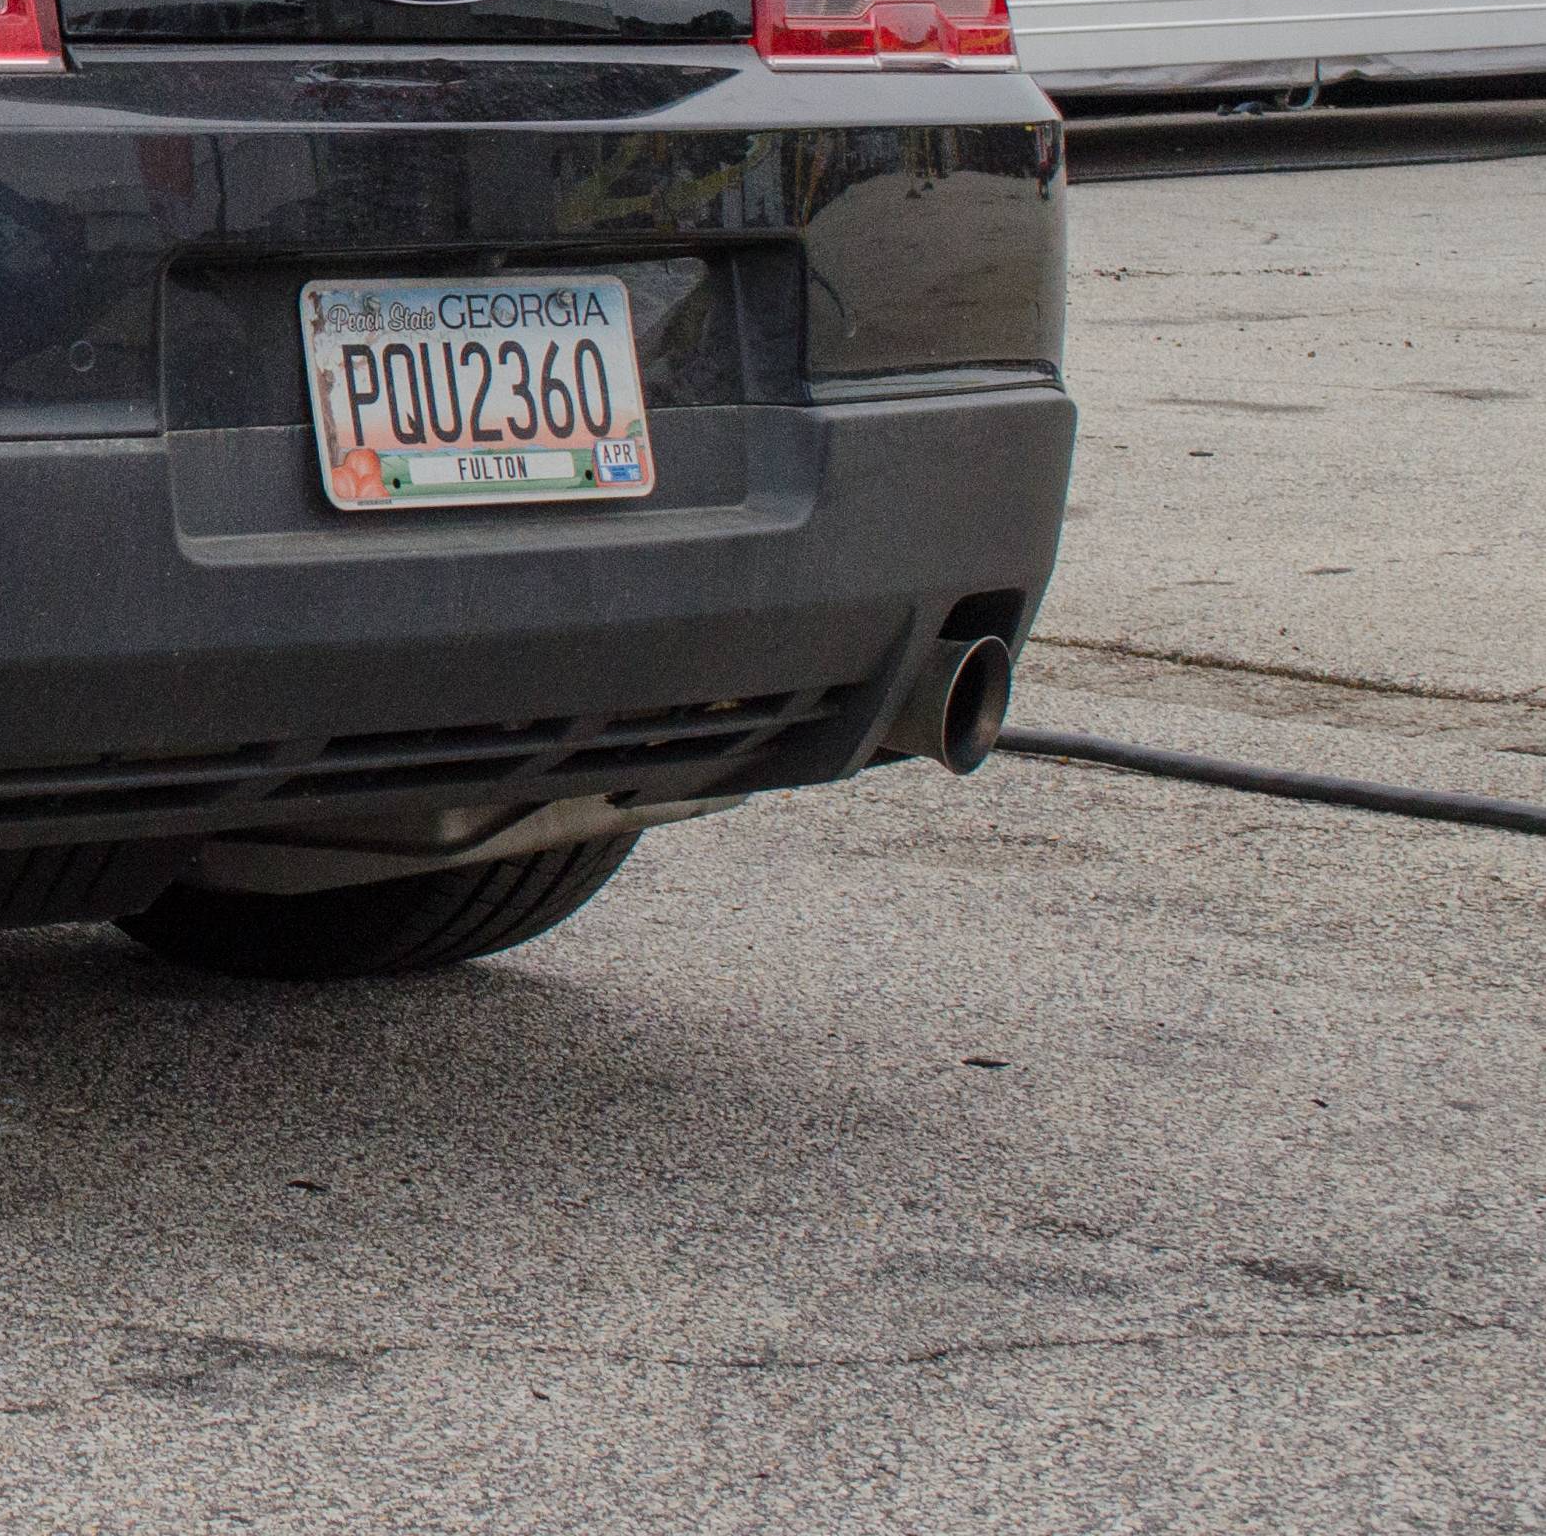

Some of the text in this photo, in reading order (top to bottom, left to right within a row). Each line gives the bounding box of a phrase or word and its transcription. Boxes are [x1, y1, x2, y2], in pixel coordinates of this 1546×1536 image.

[328, 292, 610, 333] Peach State GEORGIA
[341, 339, 613, 447] PQU2360
[458, 455, 529, 481] FULTON
[603, 444, 633, 463] APR
